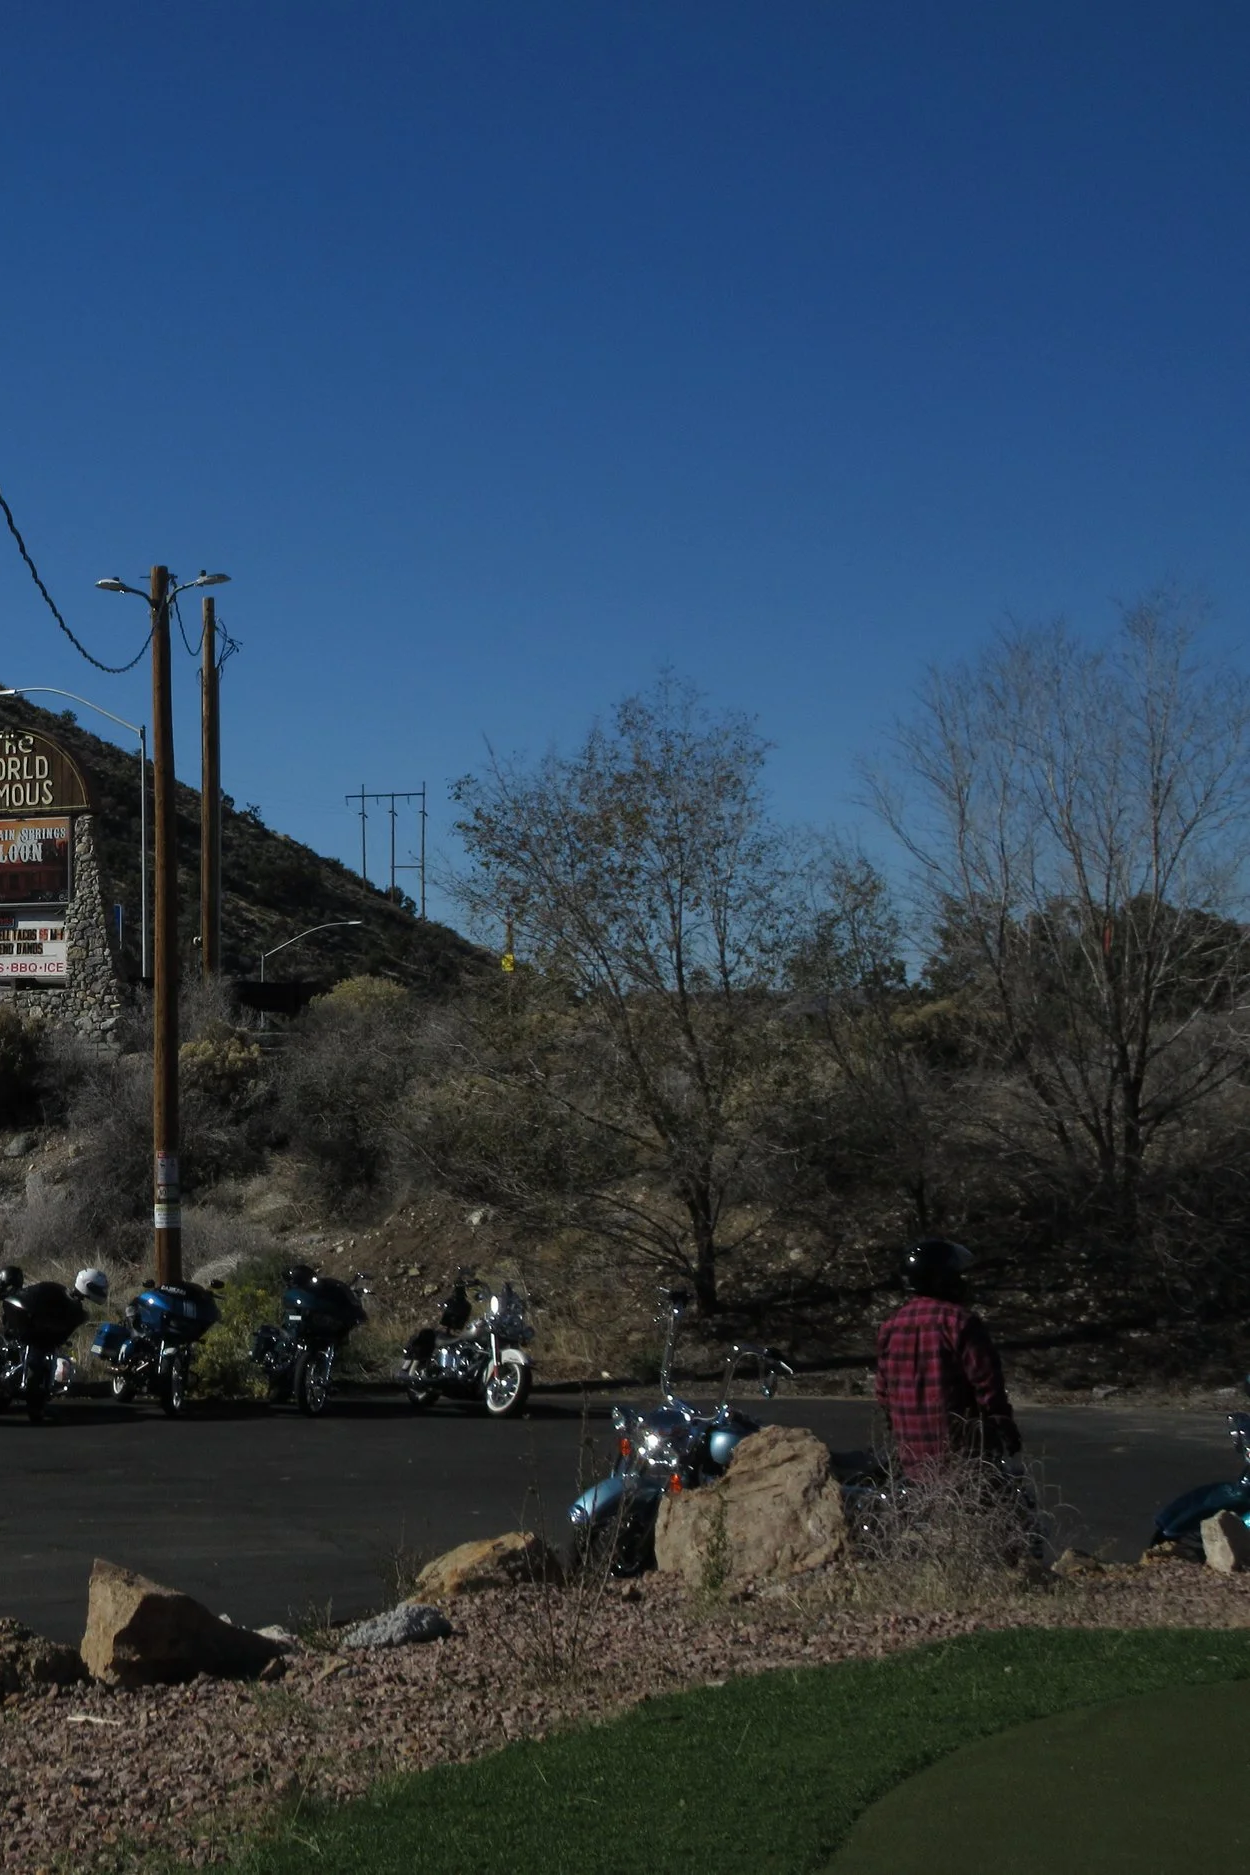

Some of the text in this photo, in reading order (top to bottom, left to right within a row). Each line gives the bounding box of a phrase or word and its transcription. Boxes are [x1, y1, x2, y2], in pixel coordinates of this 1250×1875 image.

[19, 827, 66, 842] SPRINGS
[12, 929, 37, 940] TACOS
[11, 963, 38, 973] BBQ
[44, 963, 64, 972] ICE
